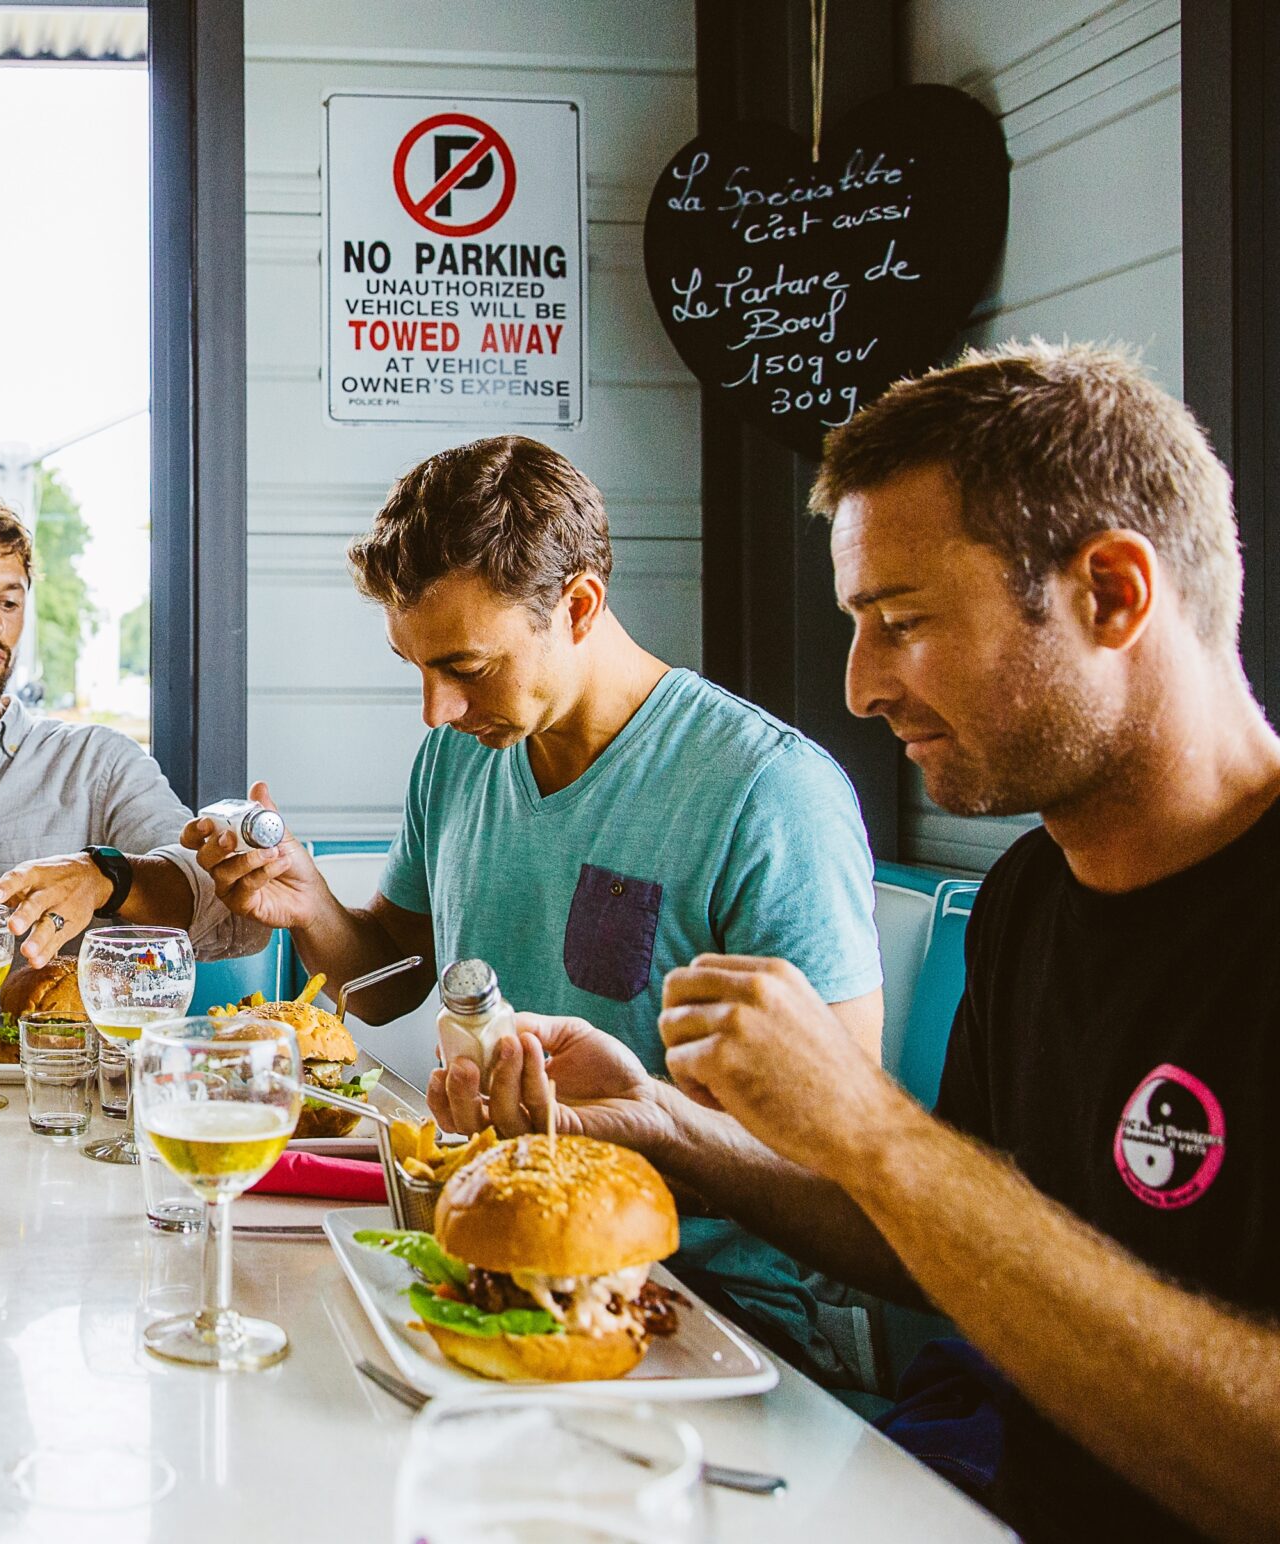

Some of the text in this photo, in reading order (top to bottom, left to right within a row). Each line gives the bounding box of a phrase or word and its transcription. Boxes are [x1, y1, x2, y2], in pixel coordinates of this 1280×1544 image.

[668, 152, 710, 212] La
[832, 195, 913, 228] aussi
[343, 240, 567, 279] NO PARKING
[365, 279, 546, 299] UNAUTHORIZED
[671, 239, 921, 323] Le Tartare de
[345, 298, 567, 320] VEHICLES WILL BE
[348, 320, 564, 355] TOWED AWAY
[385, 357, 528, 377] AT VEHICLE
[720, 353, 825, 388] 150g
[341, 376, 570, 398] OWNER'S EXPENSE
[348, 398, 382, 406] POLICE
[771, 385, 858, 428] 300g
